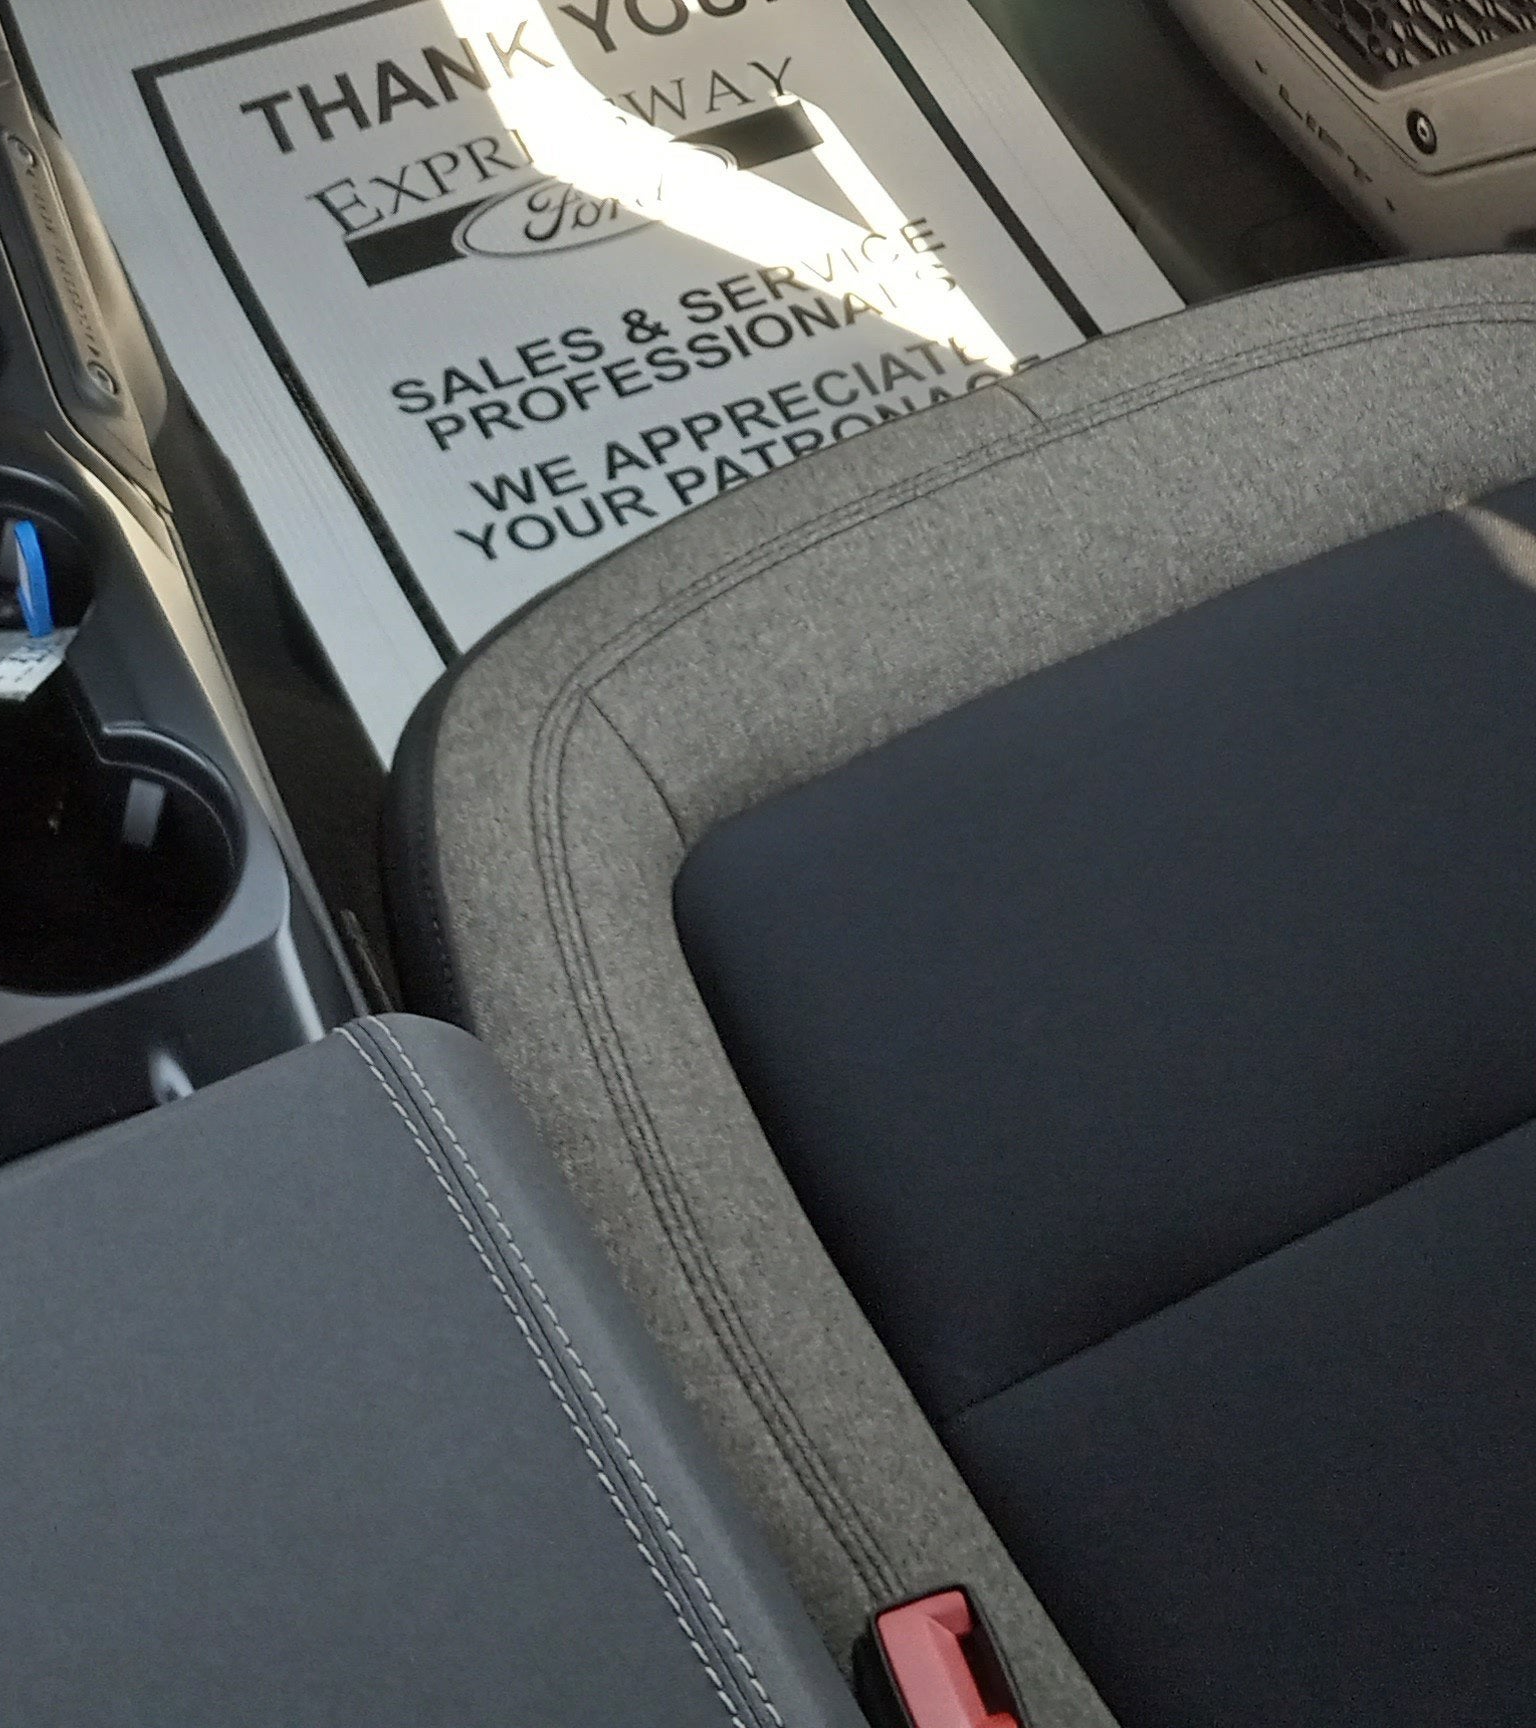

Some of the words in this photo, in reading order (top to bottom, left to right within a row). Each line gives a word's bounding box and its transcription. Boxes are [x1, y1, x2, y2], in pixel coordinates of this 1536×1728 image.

[240, 20, 555, 154] THANK
[390, 327, 606, 417] SALES
[620, 307, 671, 346] &
[678, 217, 947, 324] SERVICE
[452, 485, 660, 563] YOUR
[469, 453, 588, 513] WE
